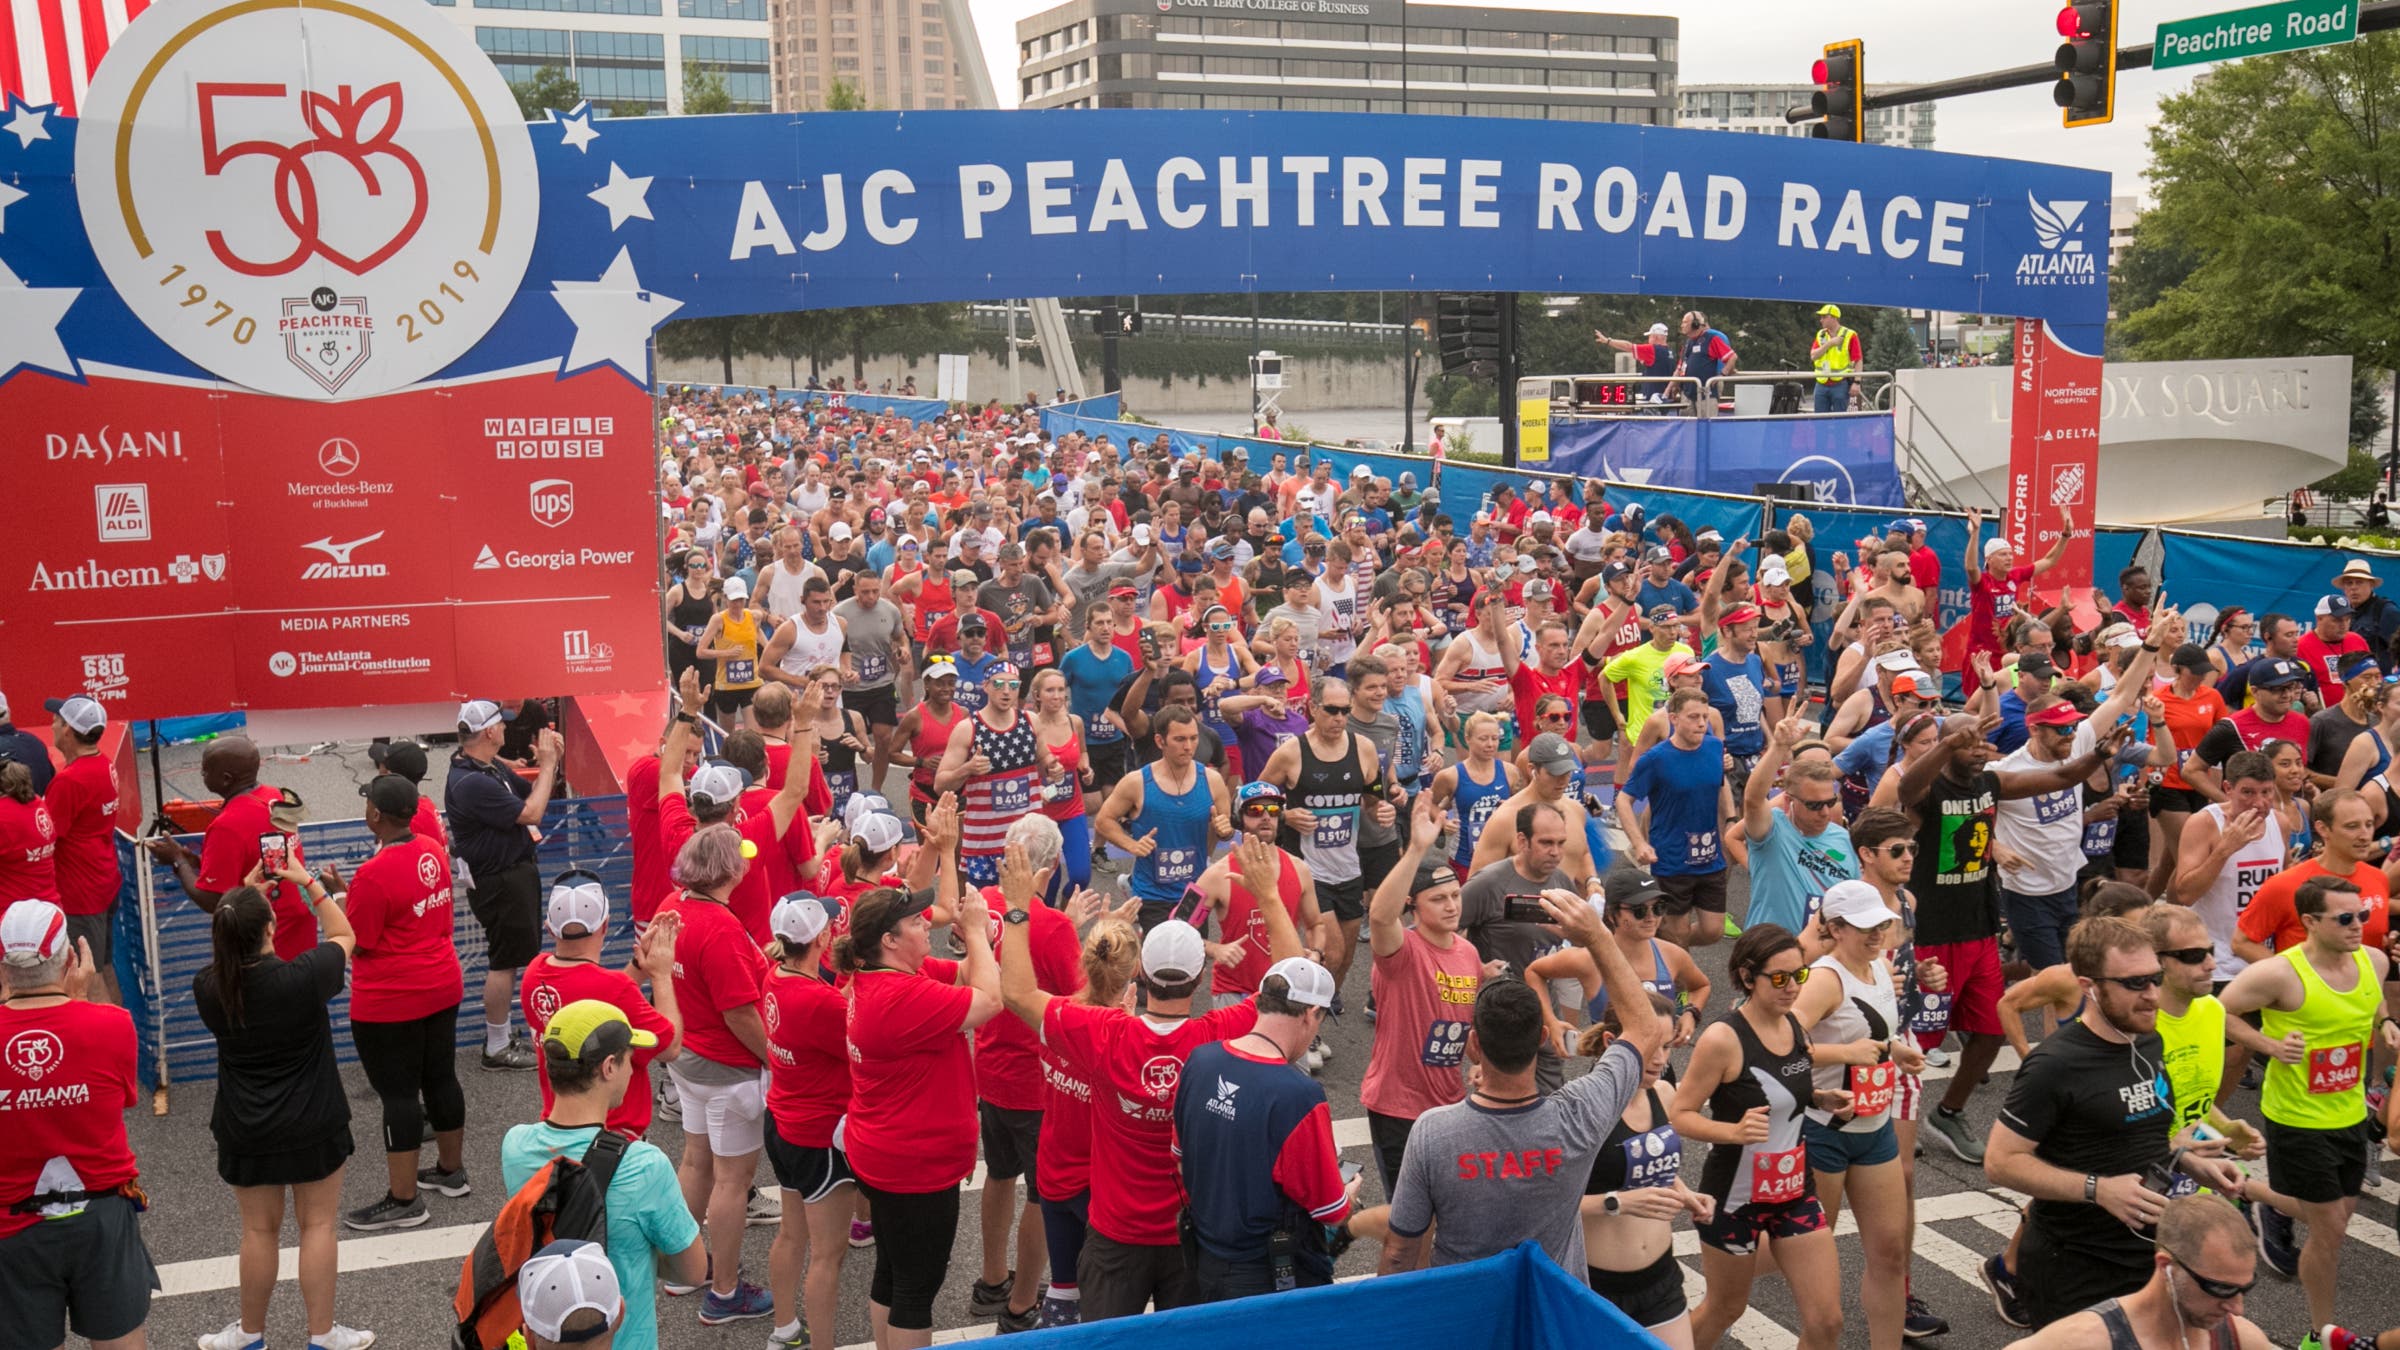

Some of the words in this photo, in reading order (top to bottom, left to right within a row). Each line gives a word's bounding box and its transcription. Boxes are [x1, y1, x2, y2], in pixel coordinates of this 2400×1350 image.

[1247, 0, 1299, 11] COLLEGE
[1301, 2, 1316, 12] OF
[1318, 0, 1370, 15] BUSINESS
[2162, 22, 2272, 58] Peachtree
[2286, 5, 2347, 37] Road
[730, 169, 919, 260] AJC
[959, 156, 1502, 239] PEACHTREE
[1538, 162, 1747, 241] ROAD
[1778, 182, 1970, 266] RACE
[2016, 253, 2095, 275] ATLANTA
[2016, 276, 2057, 285] TRACK
[2064, 276, 2095, 285] CLUB
[159, 264, 257, 345] 1970
[315, 294, 334, 305] AJC
[396, 260, 481, 343] 2019
[279, 315, 373, 331] PEACHTREE
[2045, 388, 2098, 397] NORTHSIDE
[2161, 369, 2310, 426] SQUARE
[485, 418, 613, 437] WAFFLE
[1522, 419, 1547, 427] MODERATE
[2057, 428, 2096, 439] DELTA
[46, 425, 183, 464] DASANI
[496, 440, 604, 459] HOUSE
[287, 481, 394, 496] Mercedes-Benz
[2051, 464, 2083, 504] HOME
[313, 499, 323, 508] of
[324, 499, 369, 508] Buckhead
[534, 495, 571, 519] ups
[2014, 473, 2028, 556] #AJCPRR
[105, 519, 143, 530] ALDI
[505, 550, 577, 571] Georgia
[581, 547, 634, 567] Power
[28, 559, 162, 592] Anthem
[281, 618, 329, 631] MEDIA
[332, 613, 411, 629] PARTNERS
[1615, 622, 1641, 646] USA
[298, 652, 324, 662] The
[325, 650, 372, 662] Atlanta
[84, 660, 125, 677] 680
[299, 657, 431, 675] Journal-Constitution
[995, 796, 1003, 805] B
[1942, 800, 1970, 814] ONE
[2041, 807, 2050, 817] B
[1318, 832, 1326, 841] B
[1691, 848, 1699, 856] B
[1159, 867, 1168, 876] B
[1937, 874, 1961, 884] BOB
[1923, 1010, 1948, 1021] 5383
[1430, 1041, 1440, 1053] B
[1052, 1070, 1092, 1098] ATLANTA
[2315, 1071, 2325, 1084] A
[2328, 1066, 2358, 1082] 3640
[16, 1083, 90, 1103] ATLANTA
[1858, 1092, 1868, 1106] A
[2119, 1079, 2153, 1102] FLEET
[16, 1100, 54, 1110] TRACK
[61, 1096, 90, 1107] CLUB
[1206, 1098, 1237, 1117] ATLANTA
[2128, 1095, 2156, 1113] FEET
[1458, 1147, 1564, 1180] STAFF
[1633, 1165, 1643, 1179] B
[1647, 1153, 1680, 1175] 6323
[1758, 1180, 1771, 1193] A
